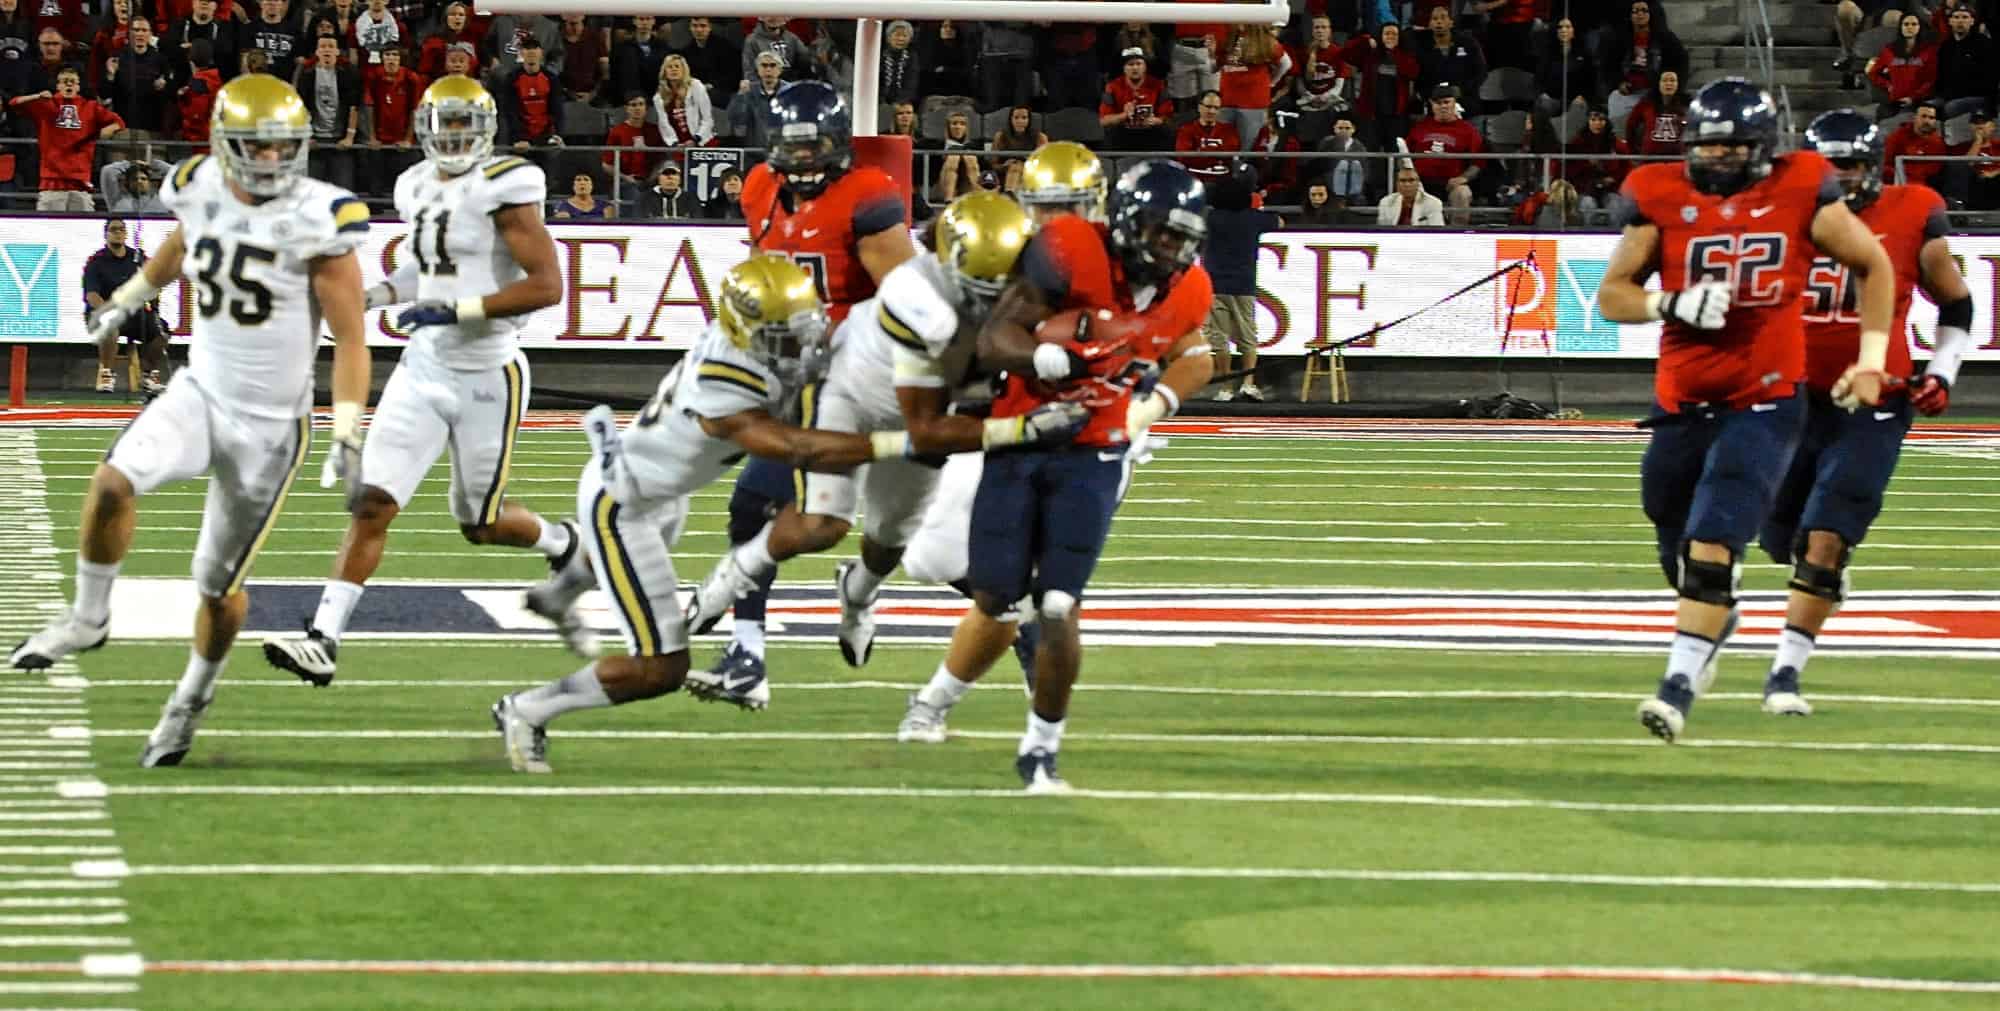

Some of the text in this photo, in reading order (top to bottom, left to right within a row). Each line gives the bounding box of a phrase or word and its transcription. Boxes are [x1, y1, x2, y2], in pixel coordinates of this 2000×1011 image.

[55, 104, 83, 129] A
[1651, 113, 1680, 142] A
[692, 151, 738, 161] SECTION
[413, 205, 457, 275] 11
[194, 237, 276, 326] 35
[1684, 232, 1788, 306] 62
